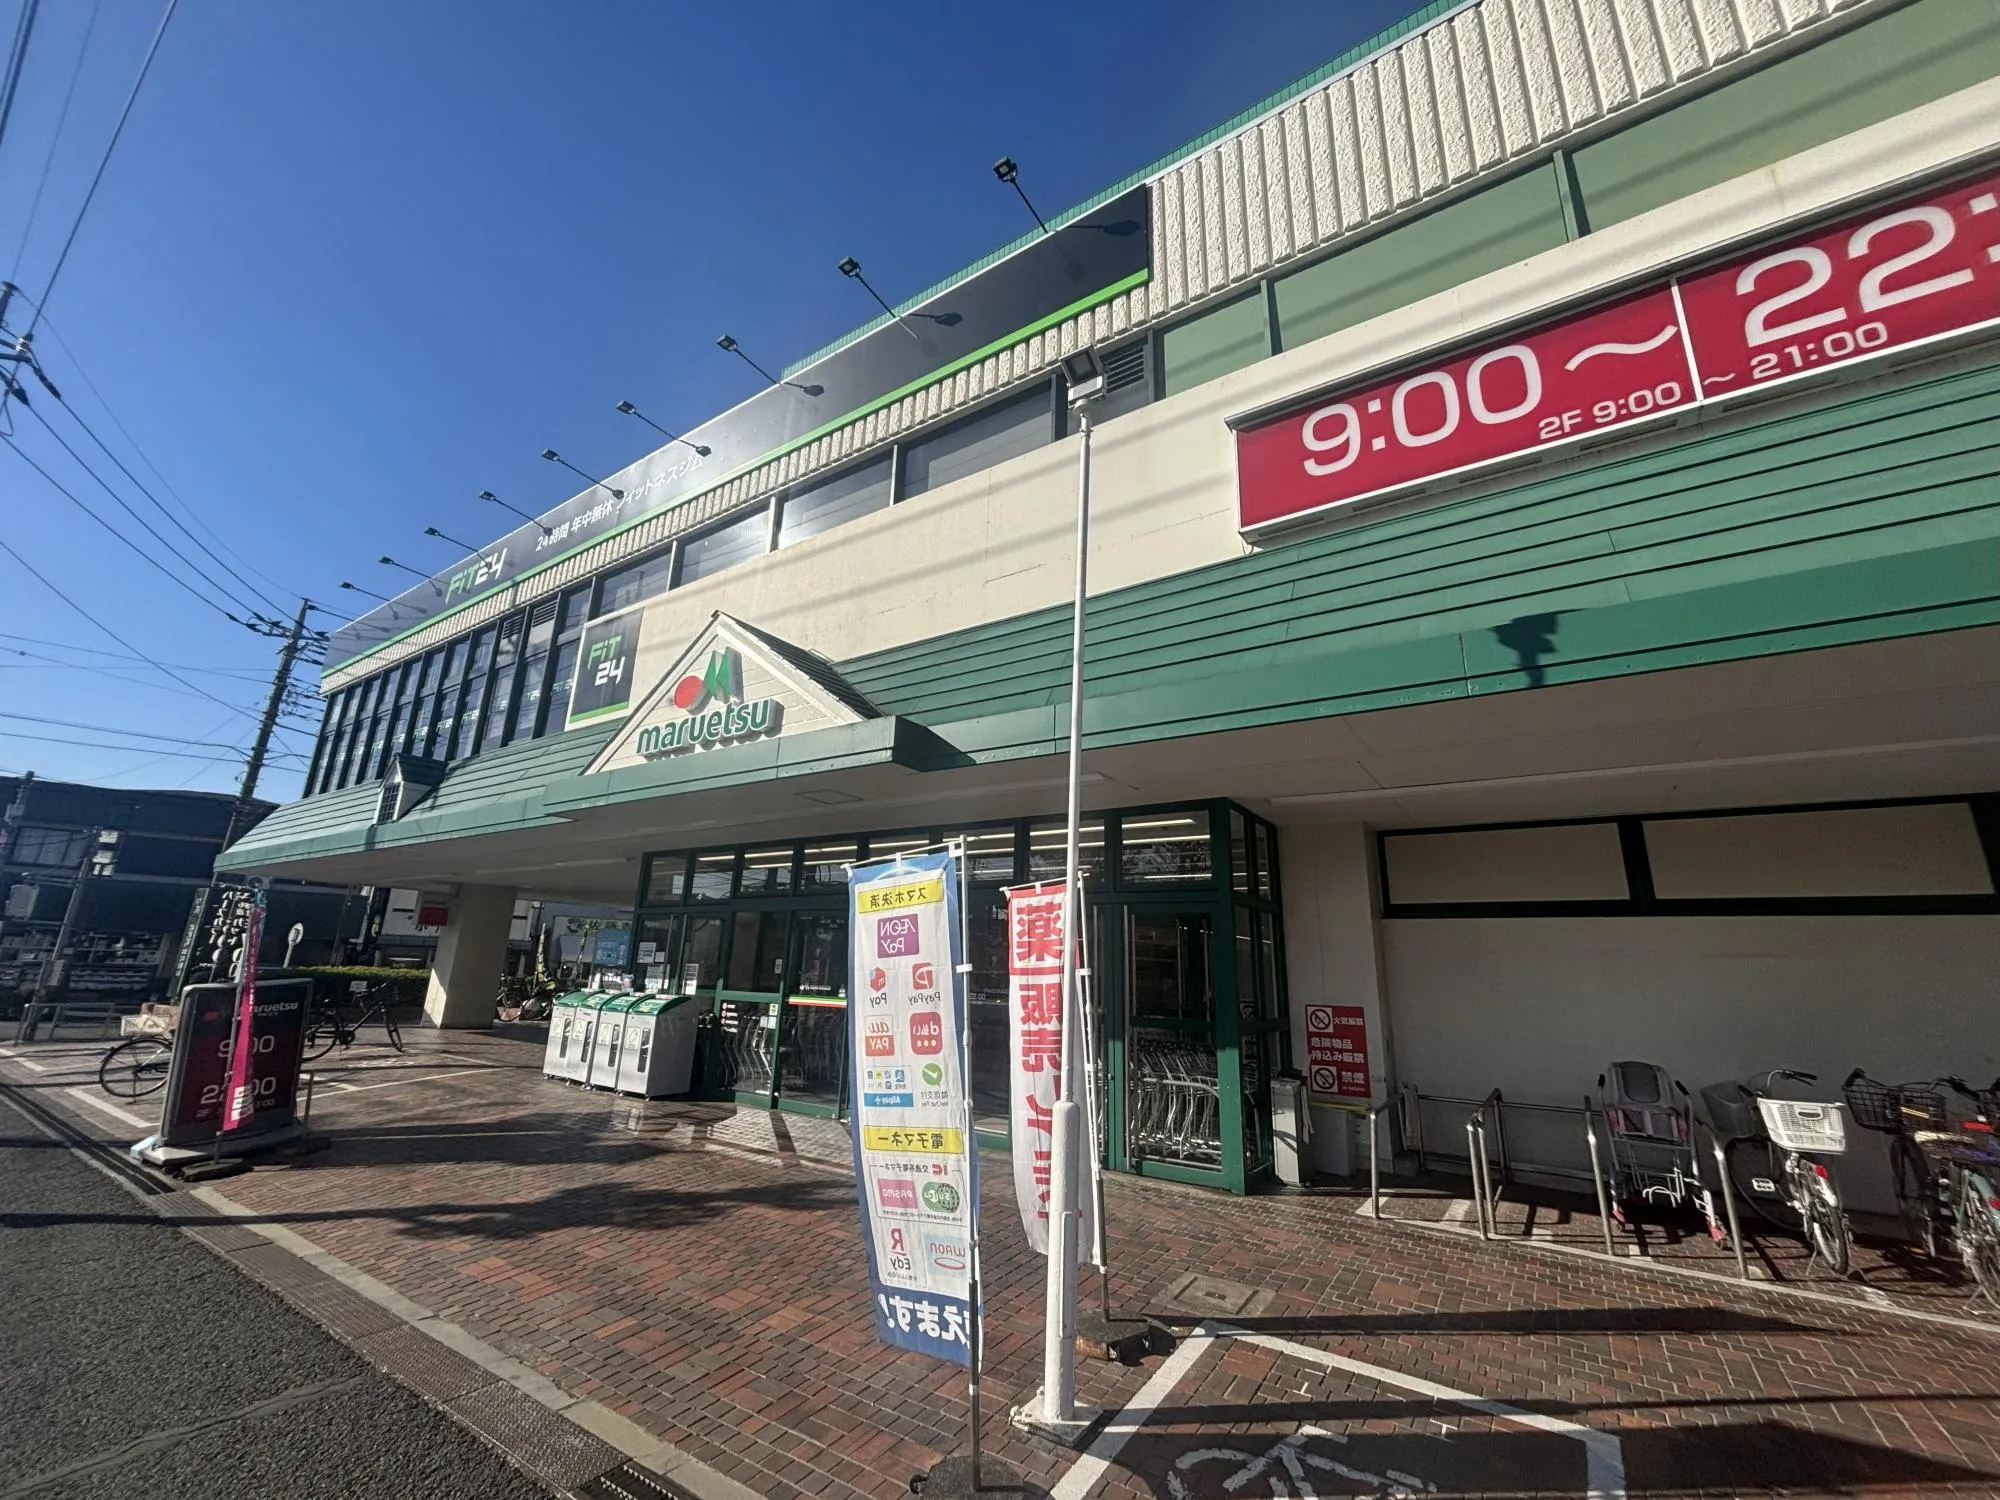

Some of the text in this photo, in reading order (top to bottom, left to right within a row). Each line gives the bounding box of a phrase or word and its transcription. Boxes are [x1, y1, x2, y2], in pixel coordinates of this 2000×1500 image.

[1538, 394, 1583, 441] 2F
[1592, 381, 1681, 423] 9:00
[1751, 321, 1889, 381] 21:00
[594, 656, 626, 686] 24
[635, 698, 771, 755] maruetsu
[1341, 1071, 1366, 1085] 禁煙
